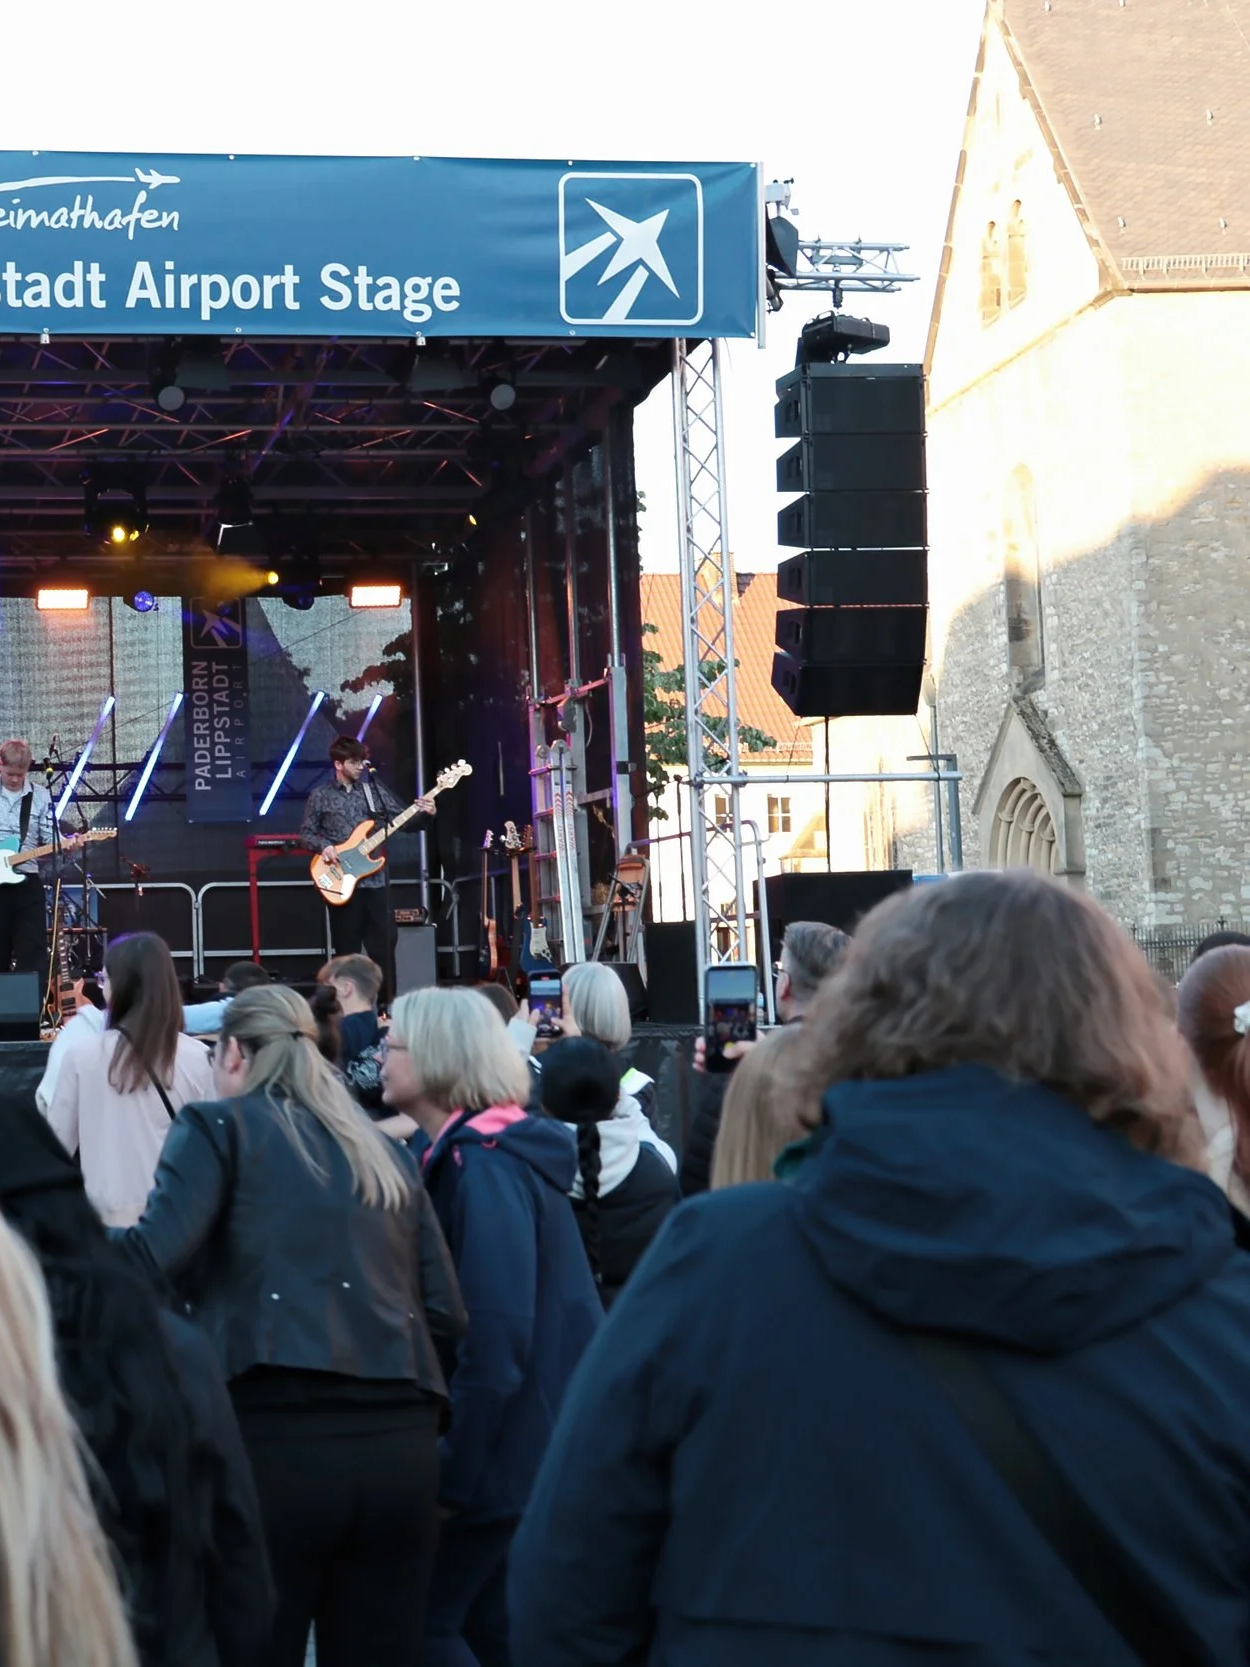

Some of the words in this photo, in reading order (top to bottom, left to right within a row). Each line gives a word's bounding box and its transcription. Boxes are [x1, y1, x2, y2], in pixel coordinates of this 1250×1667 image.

[124, 260, 300, 321] Airport
[319, 262, 461, 323] Stage
[191, 661, 211, 790] PADERBORN
[212, 661, 232, 778] LIPPSTADT
[233, 664, 246, 778] AIRPORT
